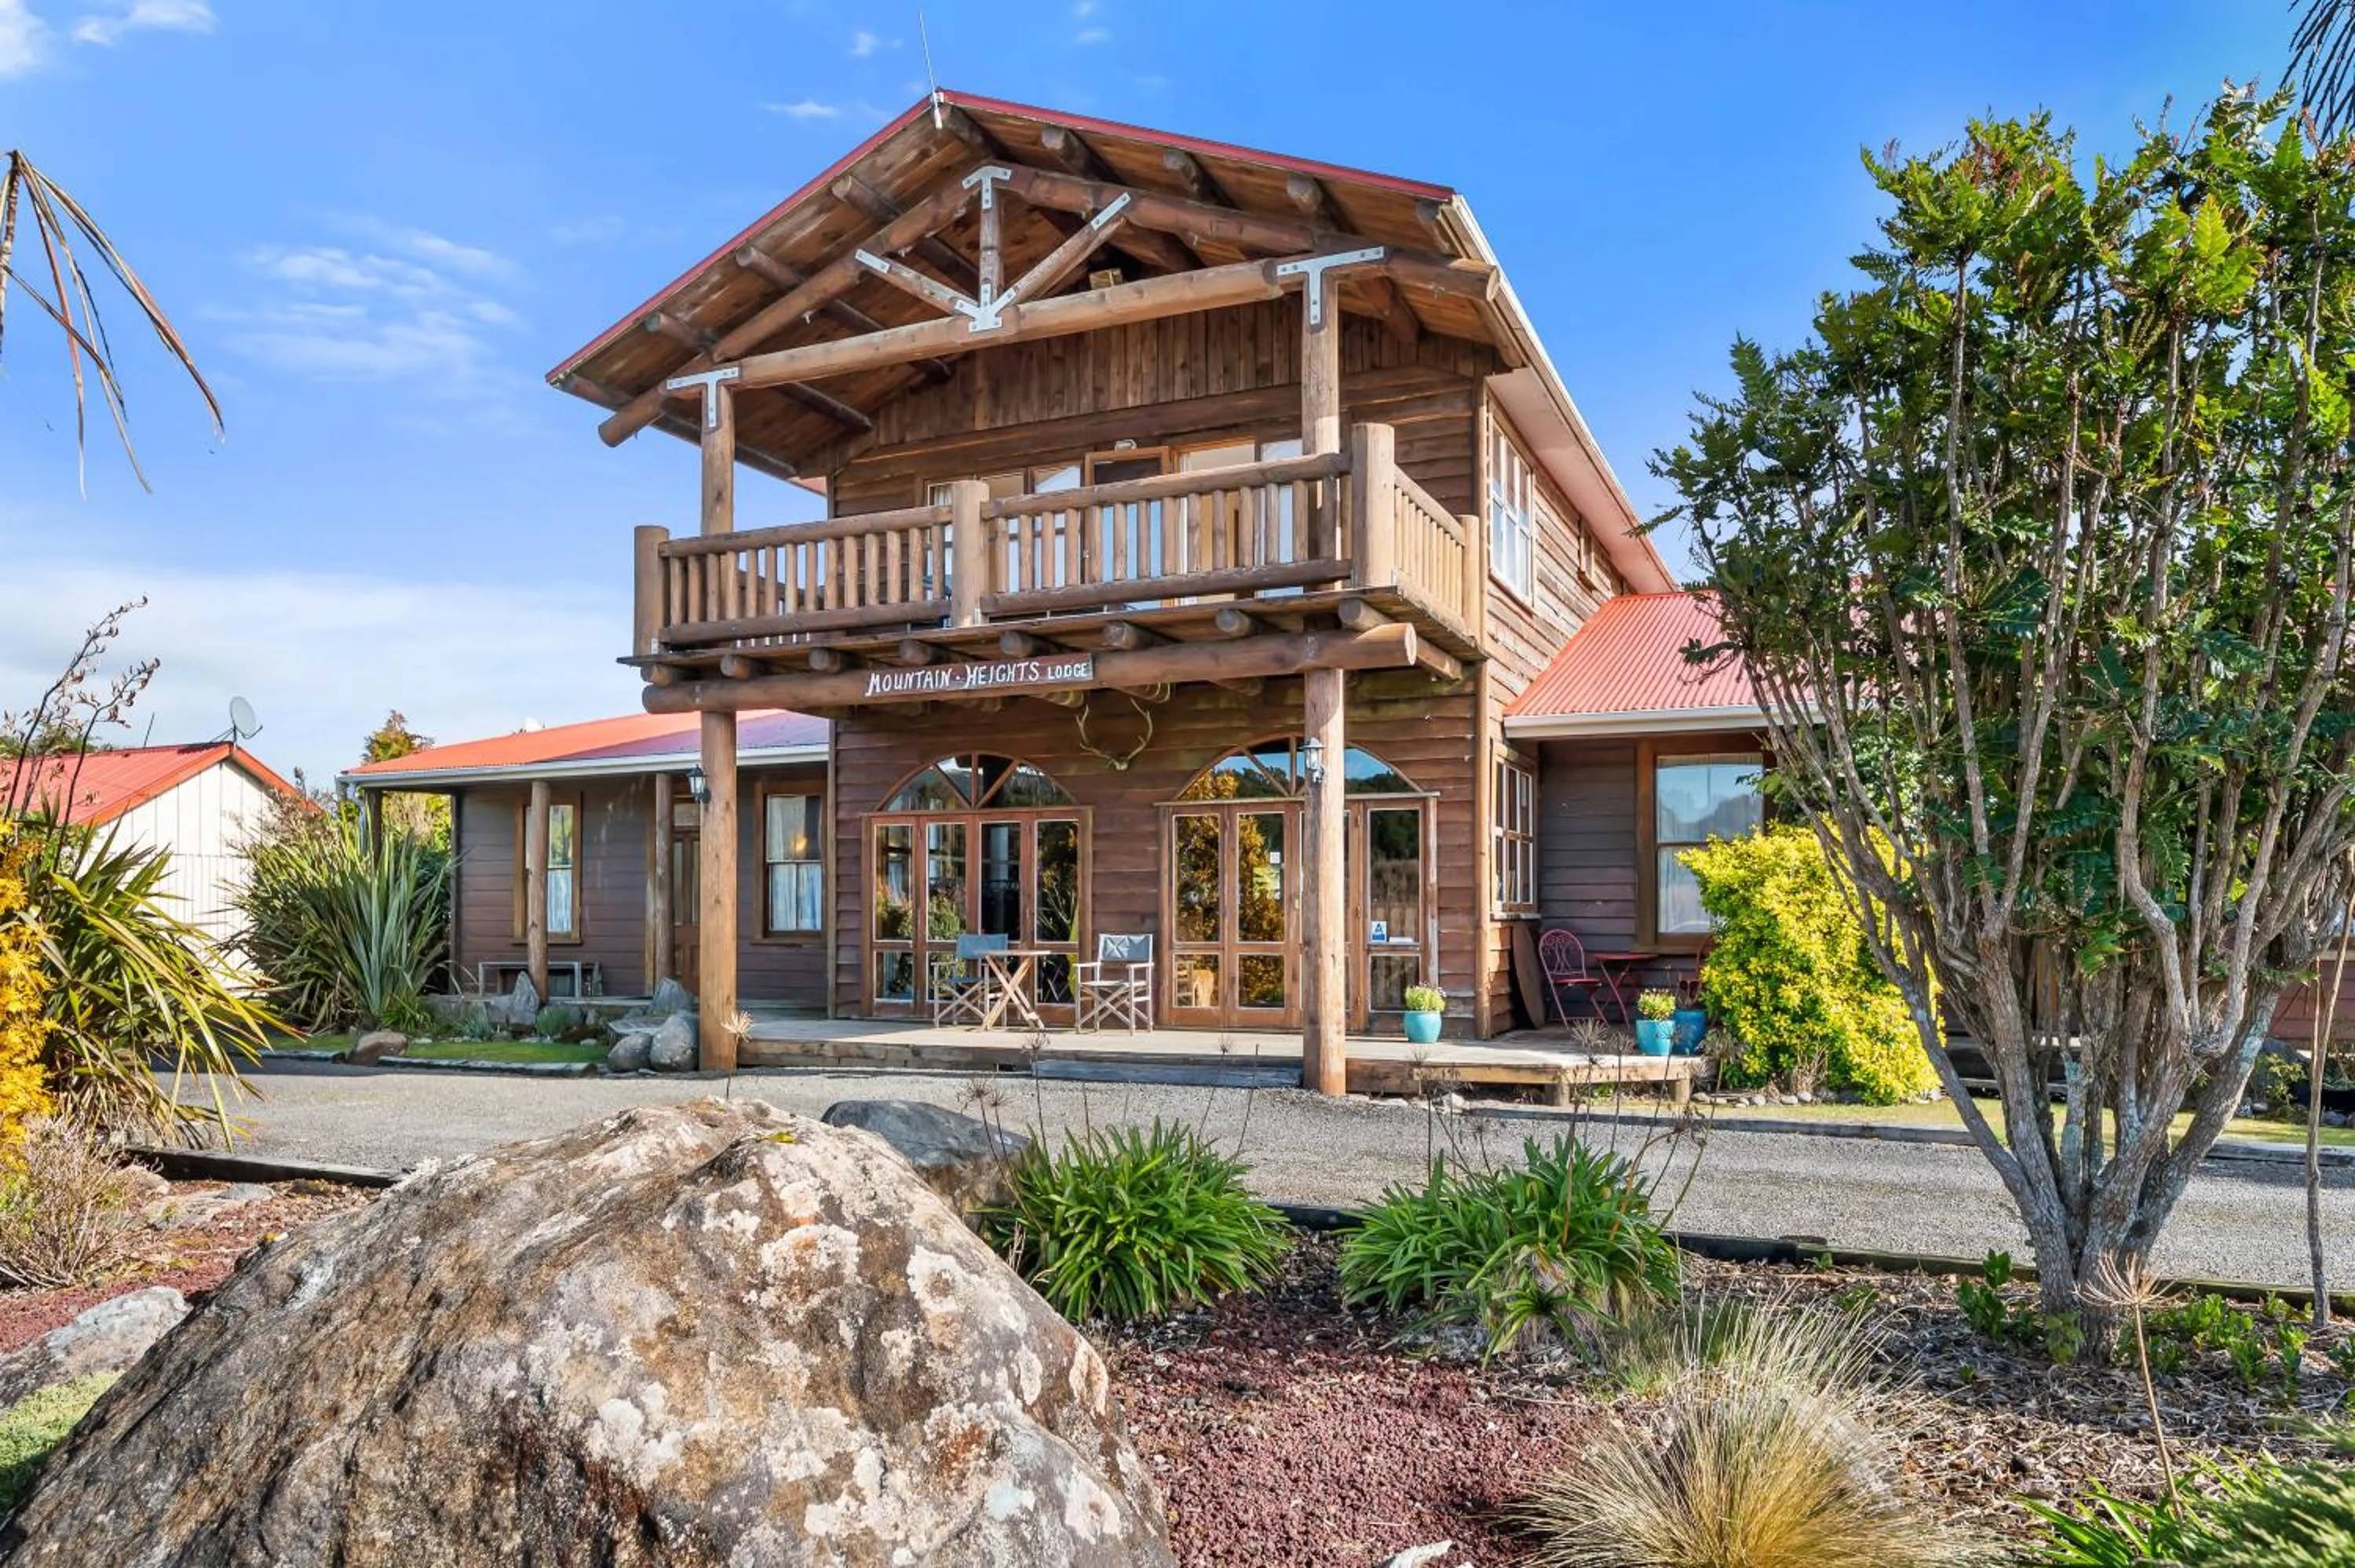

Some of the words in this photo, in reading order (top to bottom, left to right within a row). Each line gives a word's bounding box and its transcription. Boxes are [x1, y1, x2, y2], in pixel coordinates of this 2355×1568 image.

[864, 669, 951, 697] MOUNTAIN
[964, 662, 1040, 688] HEIGHTS
[1047, 662, 1087, 680] LODGE
